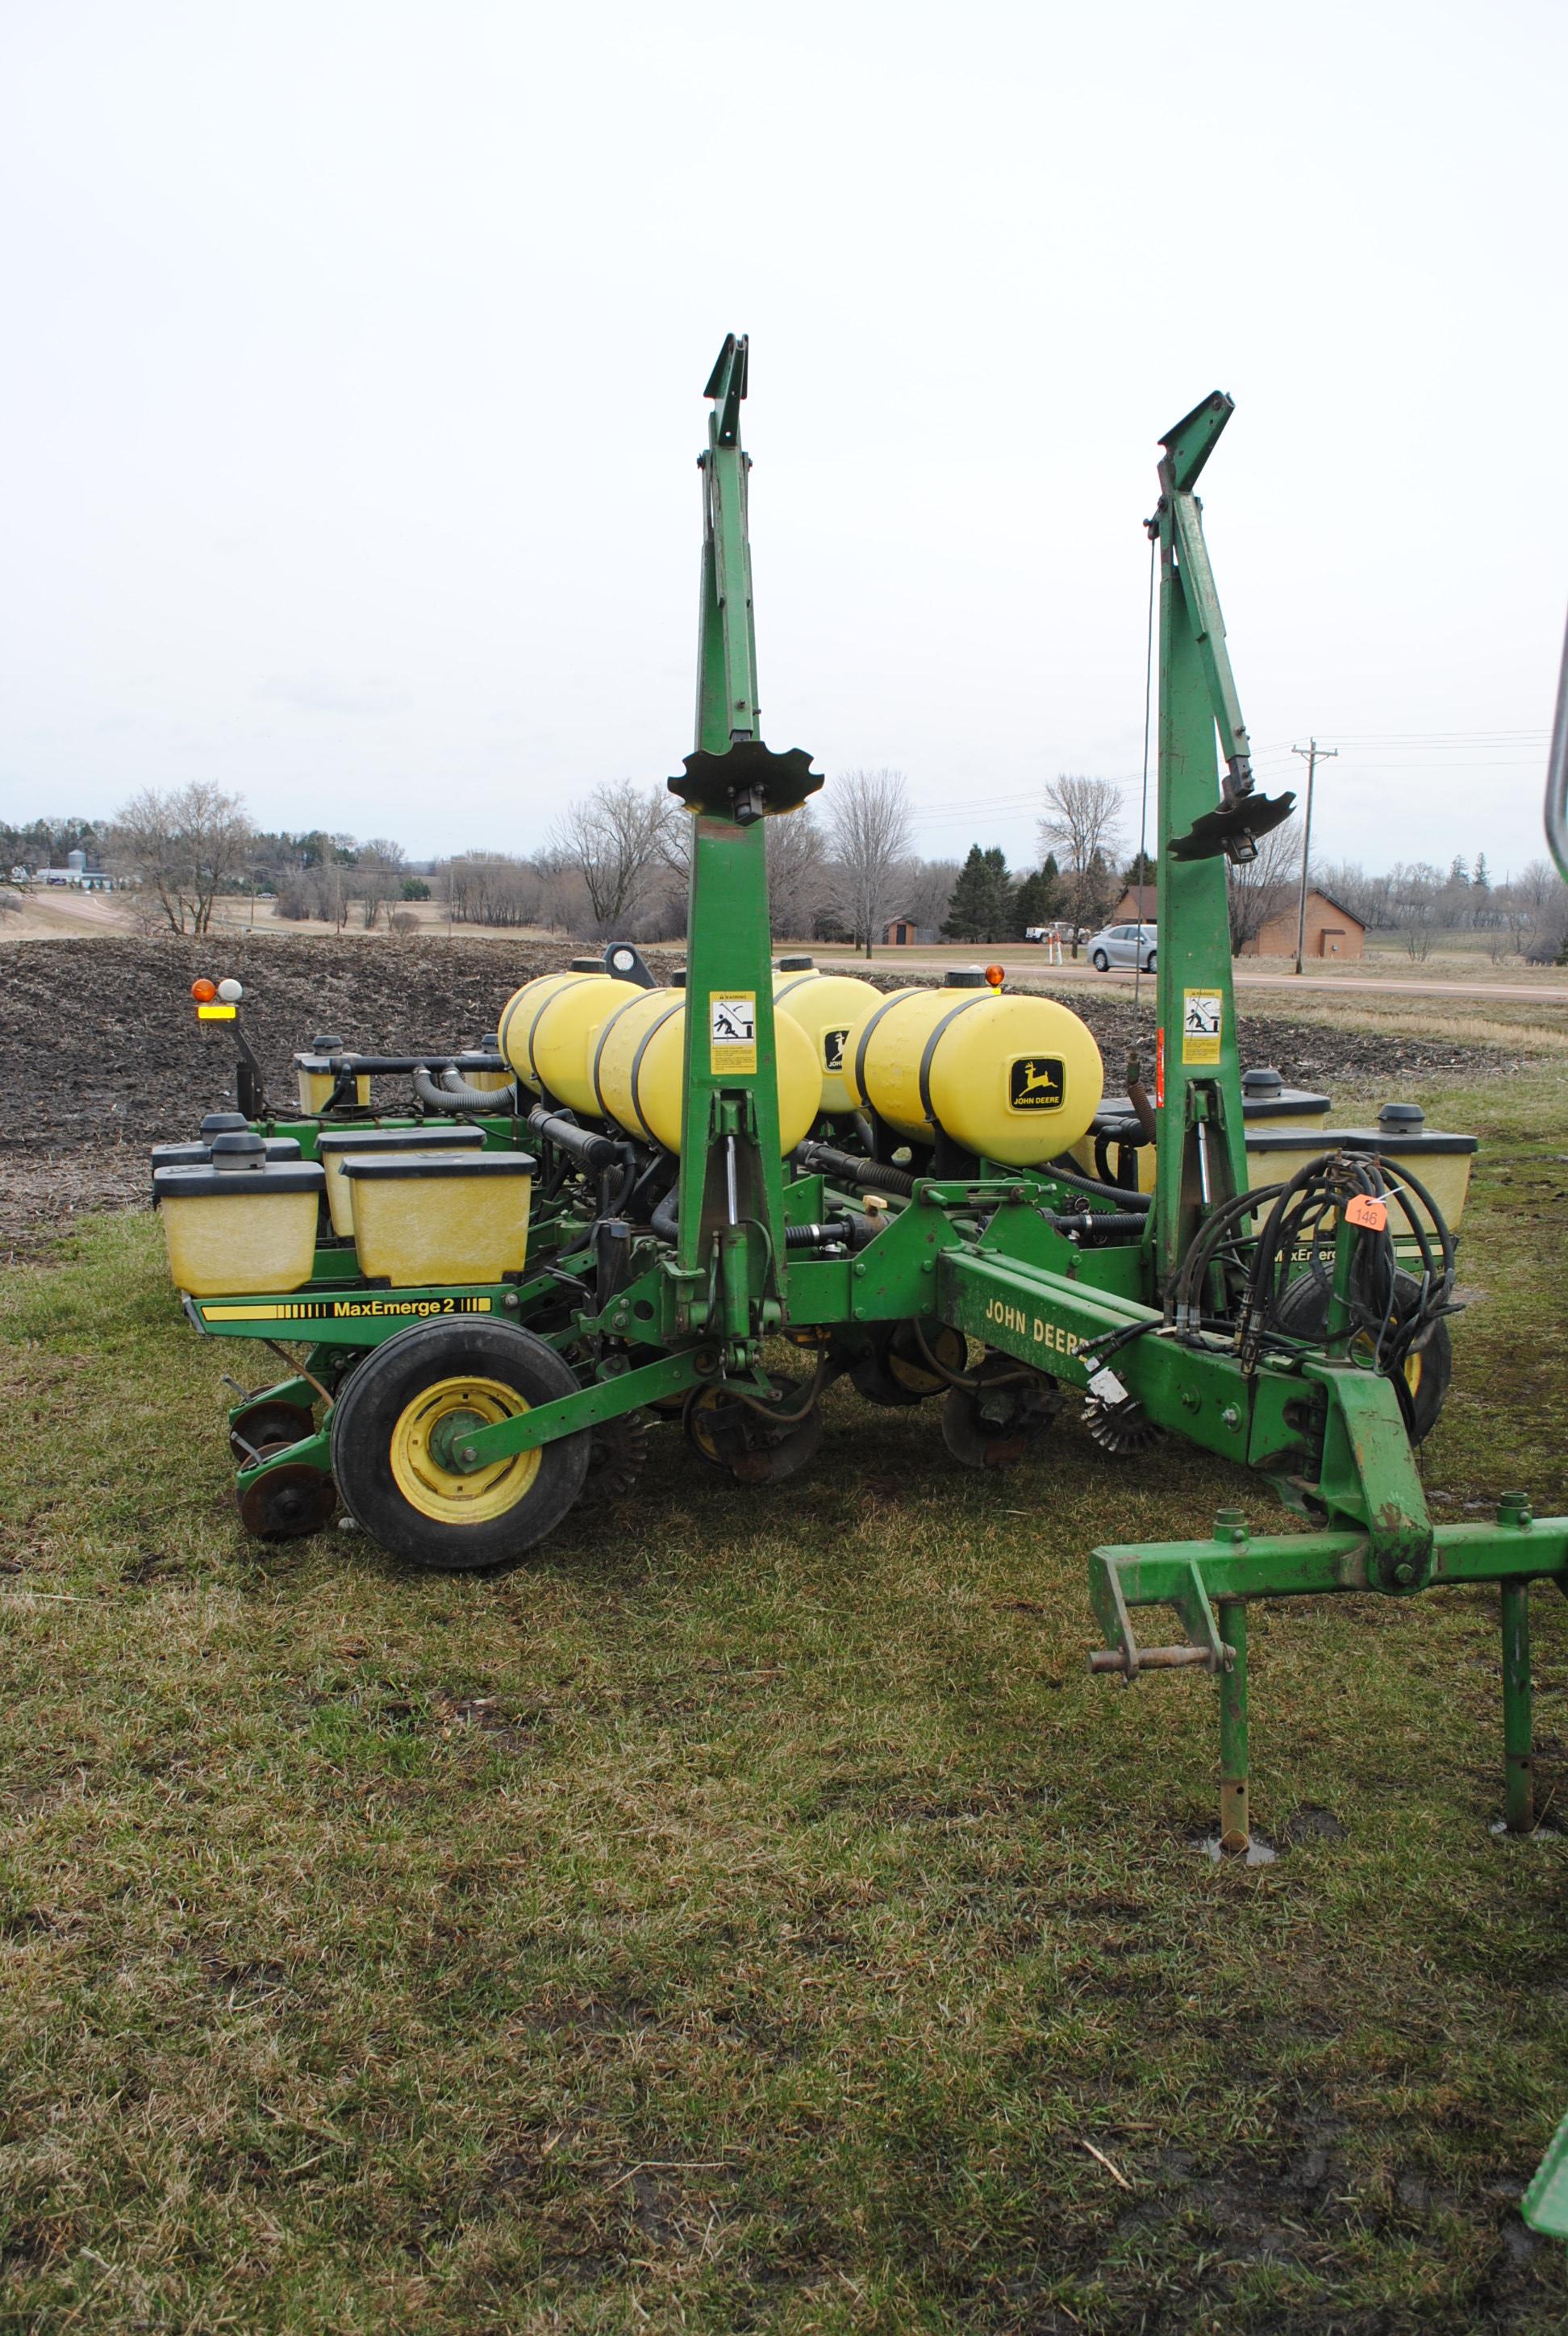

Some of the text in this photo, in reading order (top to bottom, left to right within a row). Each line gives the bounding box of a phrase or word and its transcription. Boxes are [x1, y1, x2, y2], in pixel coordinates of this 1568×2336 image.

[1014, 1096, 1060, 1105] JOHN DEERE
[1356, 1208, 1378, 1225] 146
[334, 1298, 455, 1317] MaxEmerge 2
[986, 1298, 1026, 1335] JOHN
